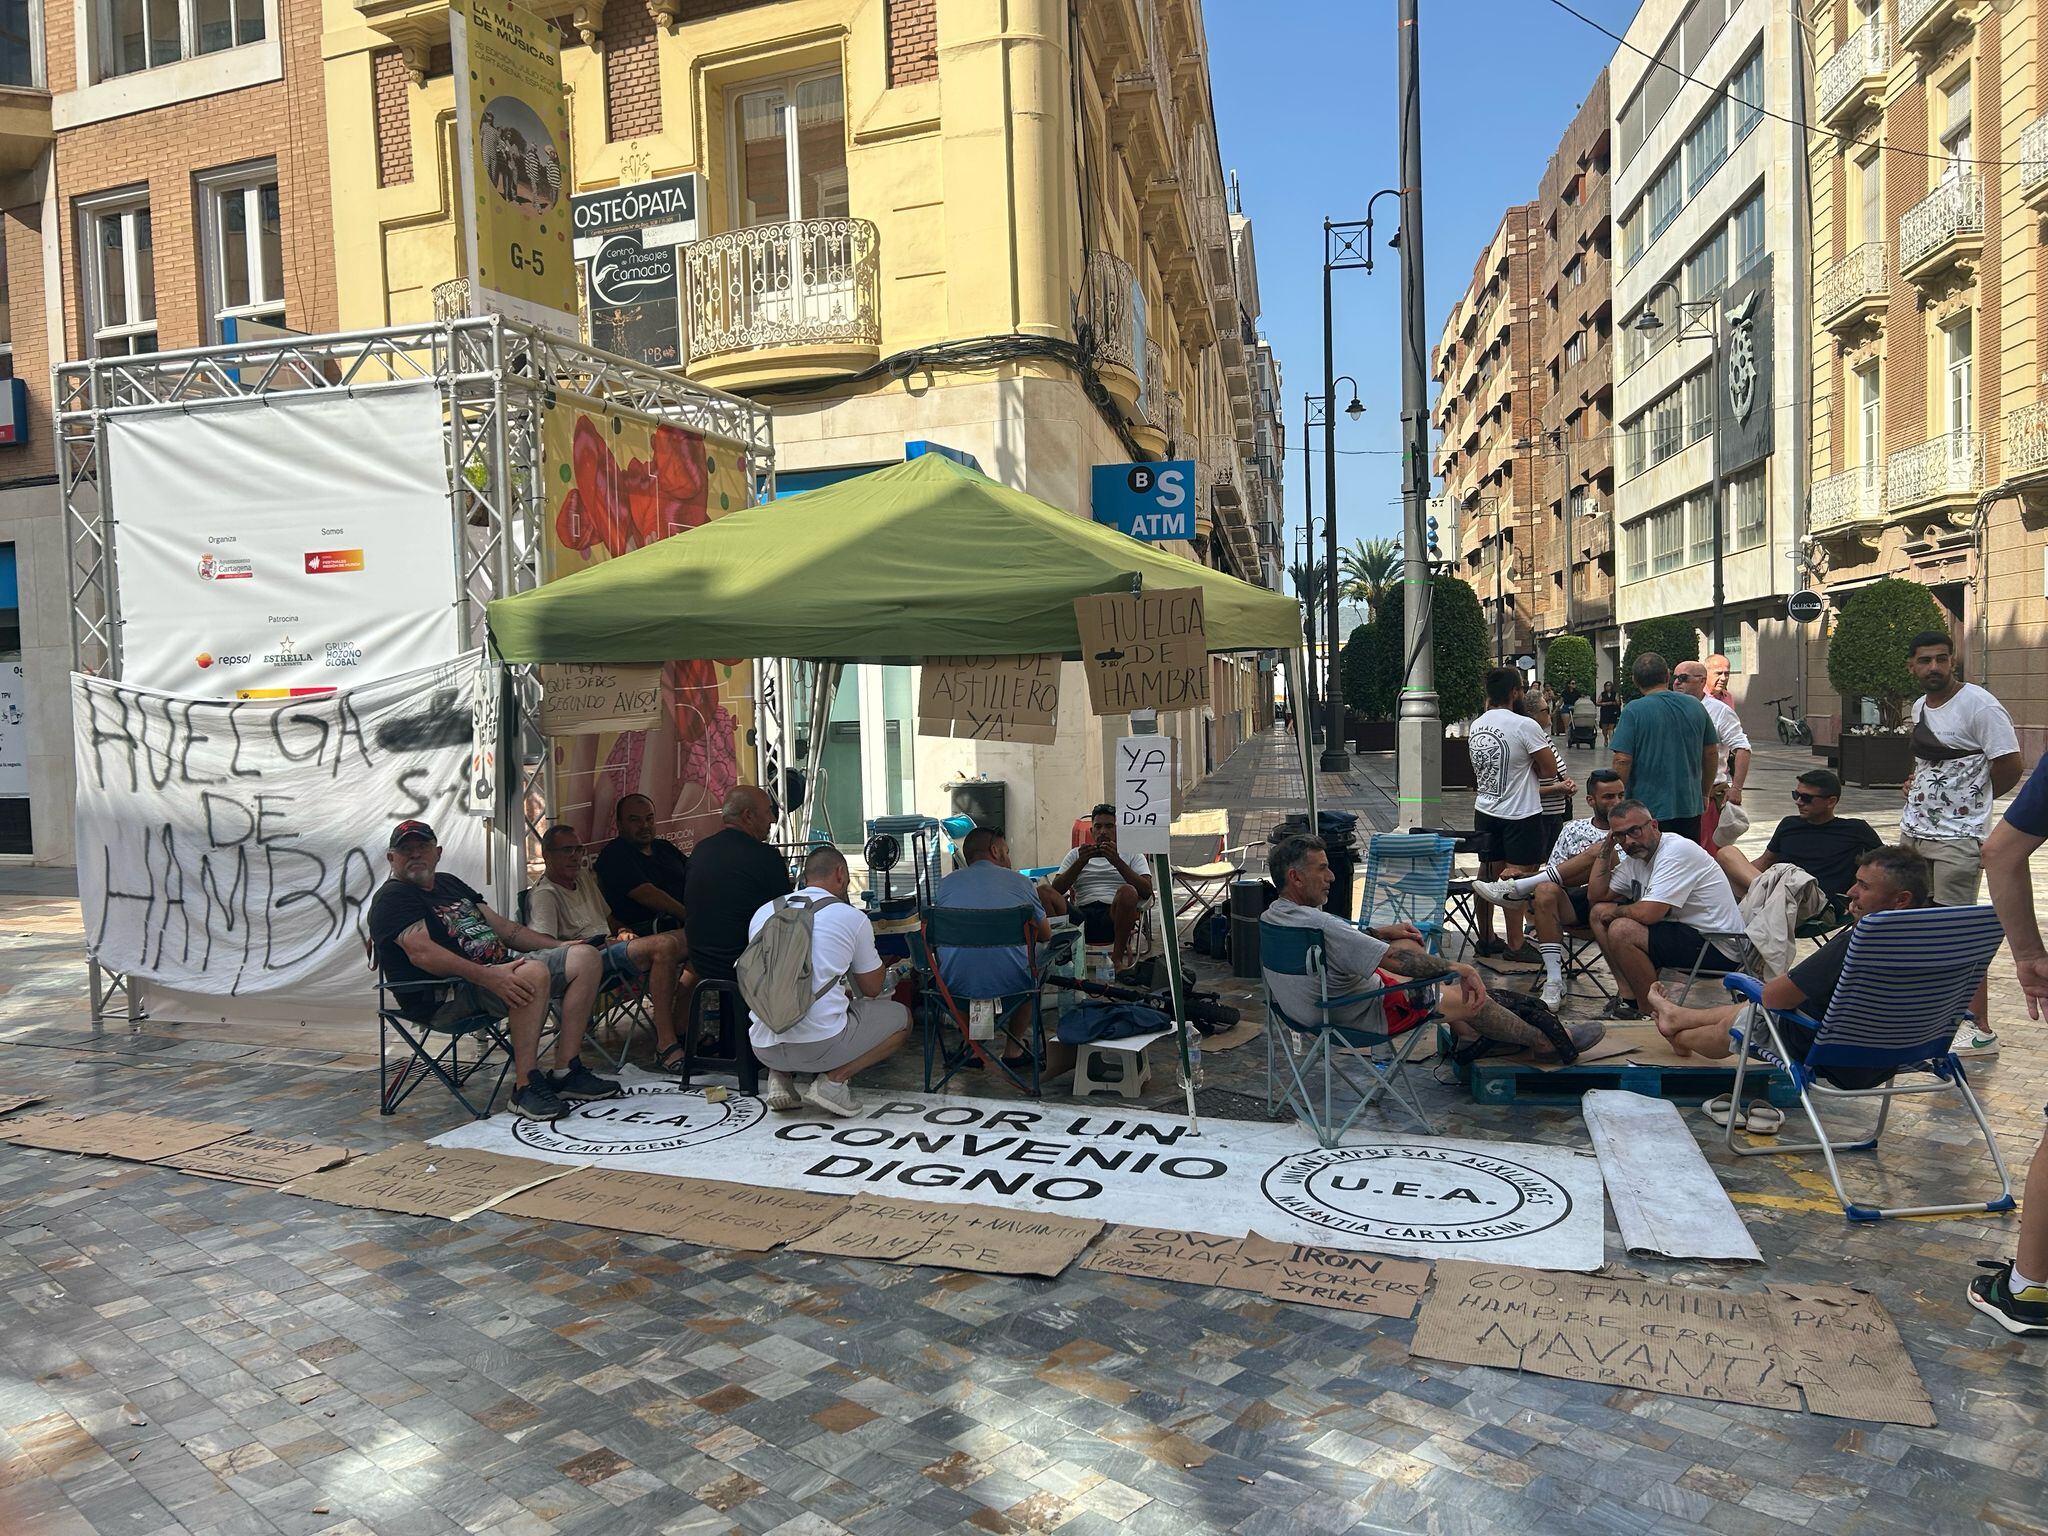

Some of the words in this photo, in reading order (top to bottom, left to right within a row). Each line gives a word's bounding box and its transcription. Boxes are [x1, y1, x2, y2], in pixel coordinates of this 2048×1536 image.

[473, 1, 489, 18] LA
[494, 13, 523, 37] MAR
[473, 15, 493, 32] DE
[574, 187, 687, 229] OSTEÓPATA
[511, 242, 545, 277] G-5
[321, 528, 344, 536] Somos
[1130, 513, 1185, 536] ATM
[208, 536, 237, 545] Organiza
[218, 564, 252, 574] Cartagena
[268, 615, 299, 624] Patrocina
[1101, 598, 1206, 643] HUELGA
[218, 653, 252, 667] repsol
[263, 653, 313, 663] ESTRELLA
[325, 641, 354, 651] GRUPO
[326, 649, 362, 658] HOZONO
[1122, 642, 1173, 671] DE
[325, 657, 358, 667] GLOBAL
[931, 671, 1058, 713] ASTILLERO
[1103, 665, 1210, 707] HAMBRE
[545, 694, 606, 713] SEGUNDO
[84, 681, 374, 794] HUELGA
[966, 709, 1016, 742] YA!
[1123, 744, 1167, 774] YA
[1126, 778, 1149, 811] 3
[201, 791, 300, 849] DE
[1123, 811, 1158, 826] DIA
[580, 1107, 693, 1128] U.E.A.
[868, 1101, 1043, 1133] POR
[1066, 1116, 1188, 1146] UN
[566, 1138, 690, 1153] CARTAGENA
[774, 1121, 1229, 1180] CONVENIO
[402, 1153, 498, 1174] HASTA
[803, 1154, 1104, 1201] DIGNO
[1317, 1148, 1450, 1164] EMPRESAS
[1461, 1157, 1554, 1206] AUXILIARES
[1330, 1175, 1498, 1206] U.E.A.
[1275, 1195, 1370, 1233] NAVANTIA
[1385, 1220, 1531, 1241] CARTAGENA
[832, 1231, 998, 1265] HAMBRE
[1128, 1228, 1233, 1248] LOW
[1126, 1243, 1276, 1269] SALARY
[1288, 1243, 1383, 1274] IRON
[1277, 1280, 1378, 1306] STRIKE
[1283, 1265, 1420, 1297] WORKERS
[1469, 1271, 1557, 1297] 600
[1580, 1283, 1769, 1320] FAMILIAS
[1458, 1293, 1621, 1330] HAMBRE
[1640, 1324, 1824, 1363] GRACIAS
[1849, 1353, 1881, 1374] A
[1475, 1321, 1841, 1398] NAVANTIA
